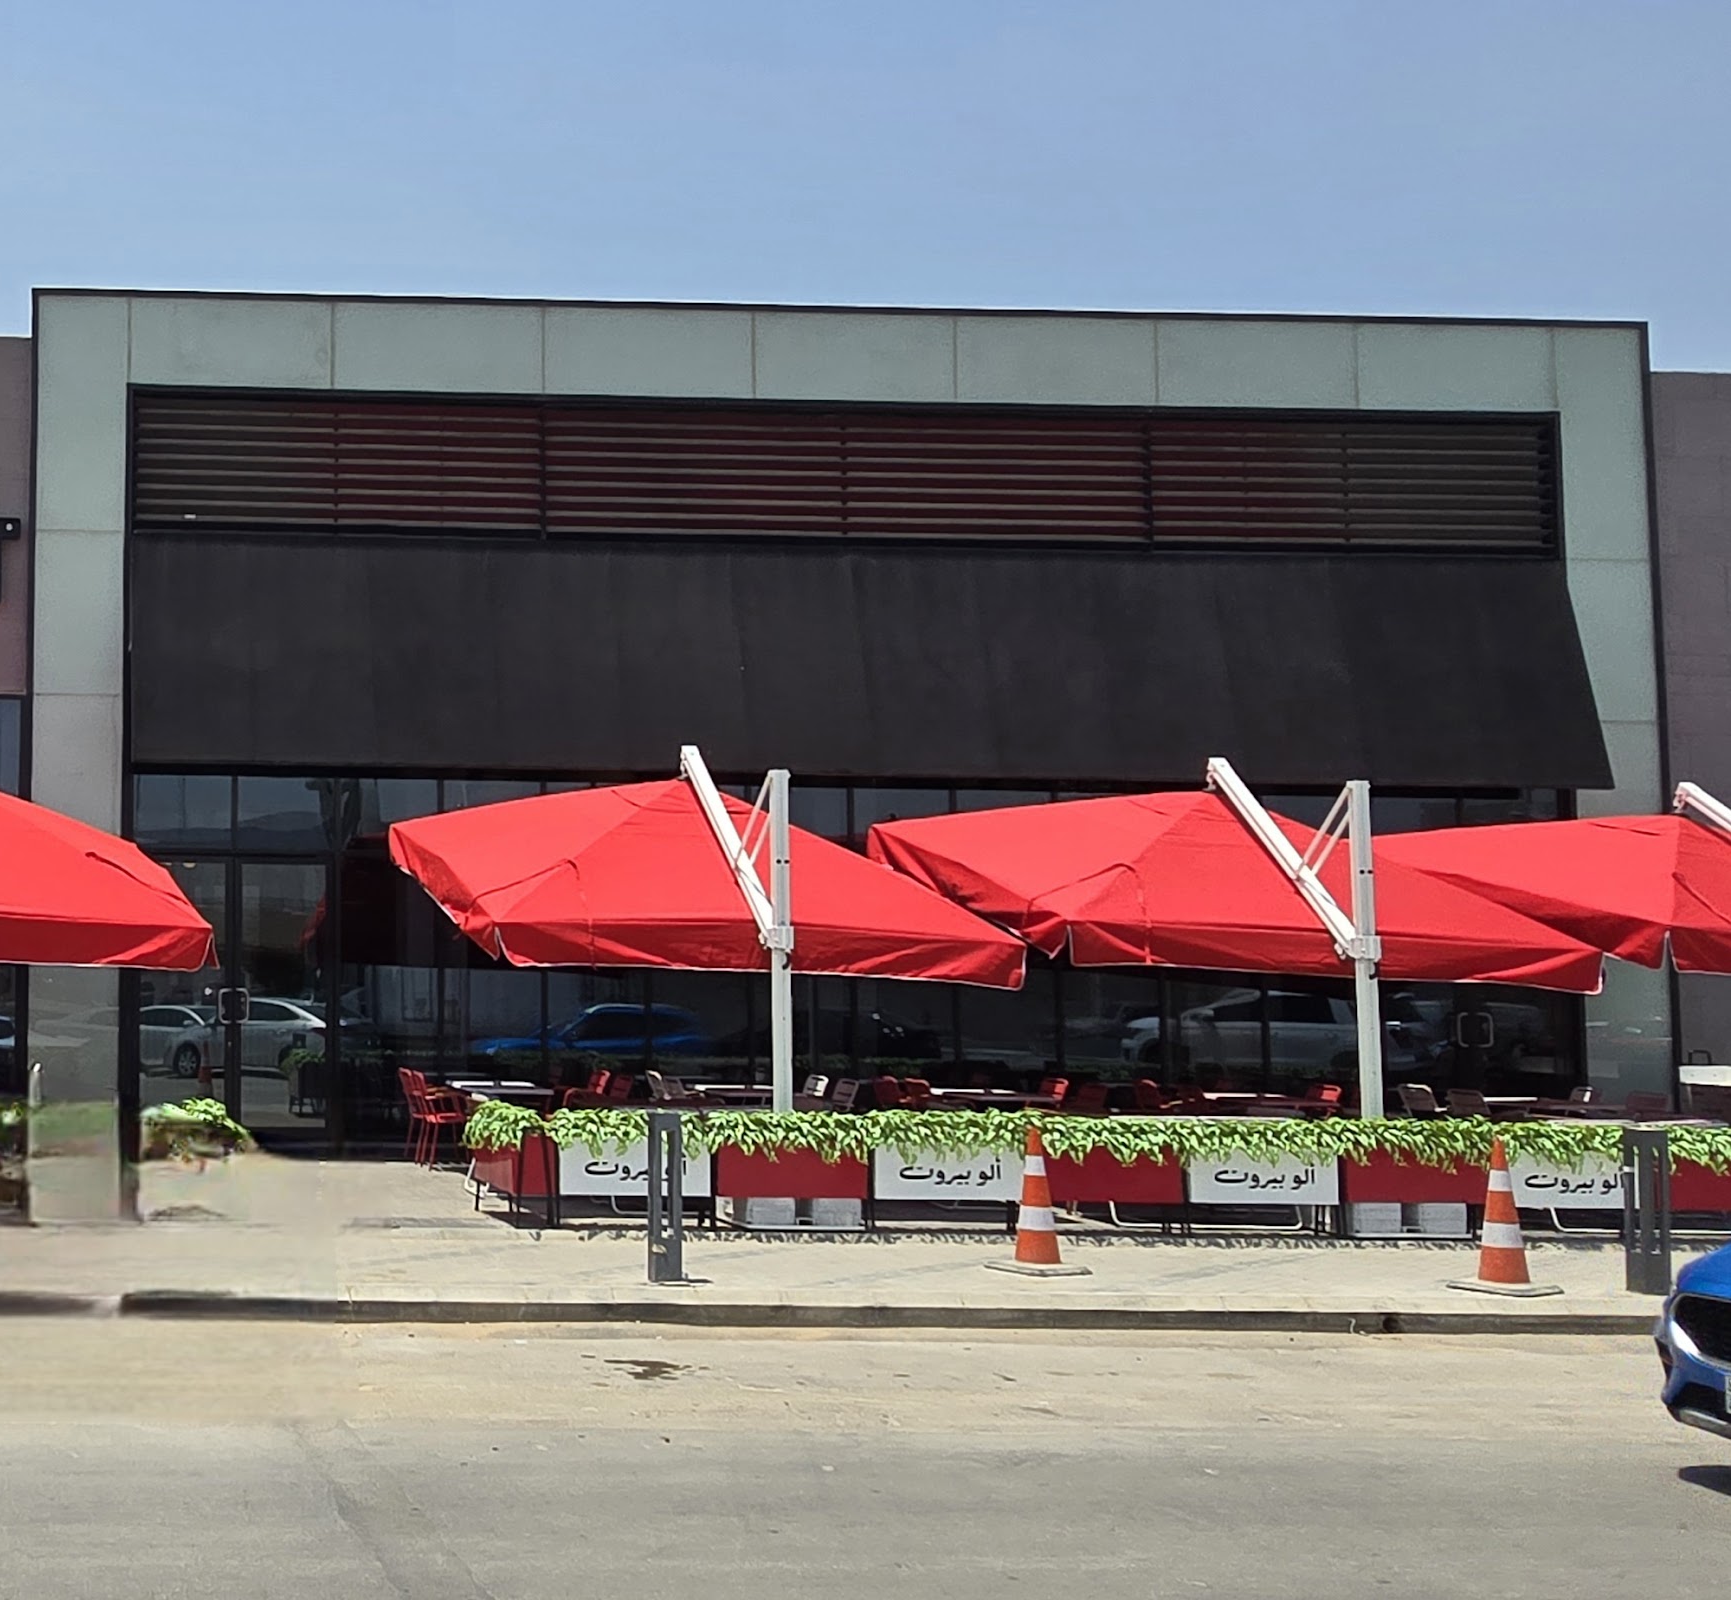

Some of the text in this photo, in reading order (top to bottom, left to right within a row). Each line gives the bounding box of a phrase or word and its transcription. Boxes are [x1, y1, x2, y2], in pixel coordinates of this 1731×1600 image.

[899, 1157, 1001, 1186] ألو بيروت
[1214, 1169, 1285, 1189] بيروت
[1524, 1174, 1594, 1193] بيروت
